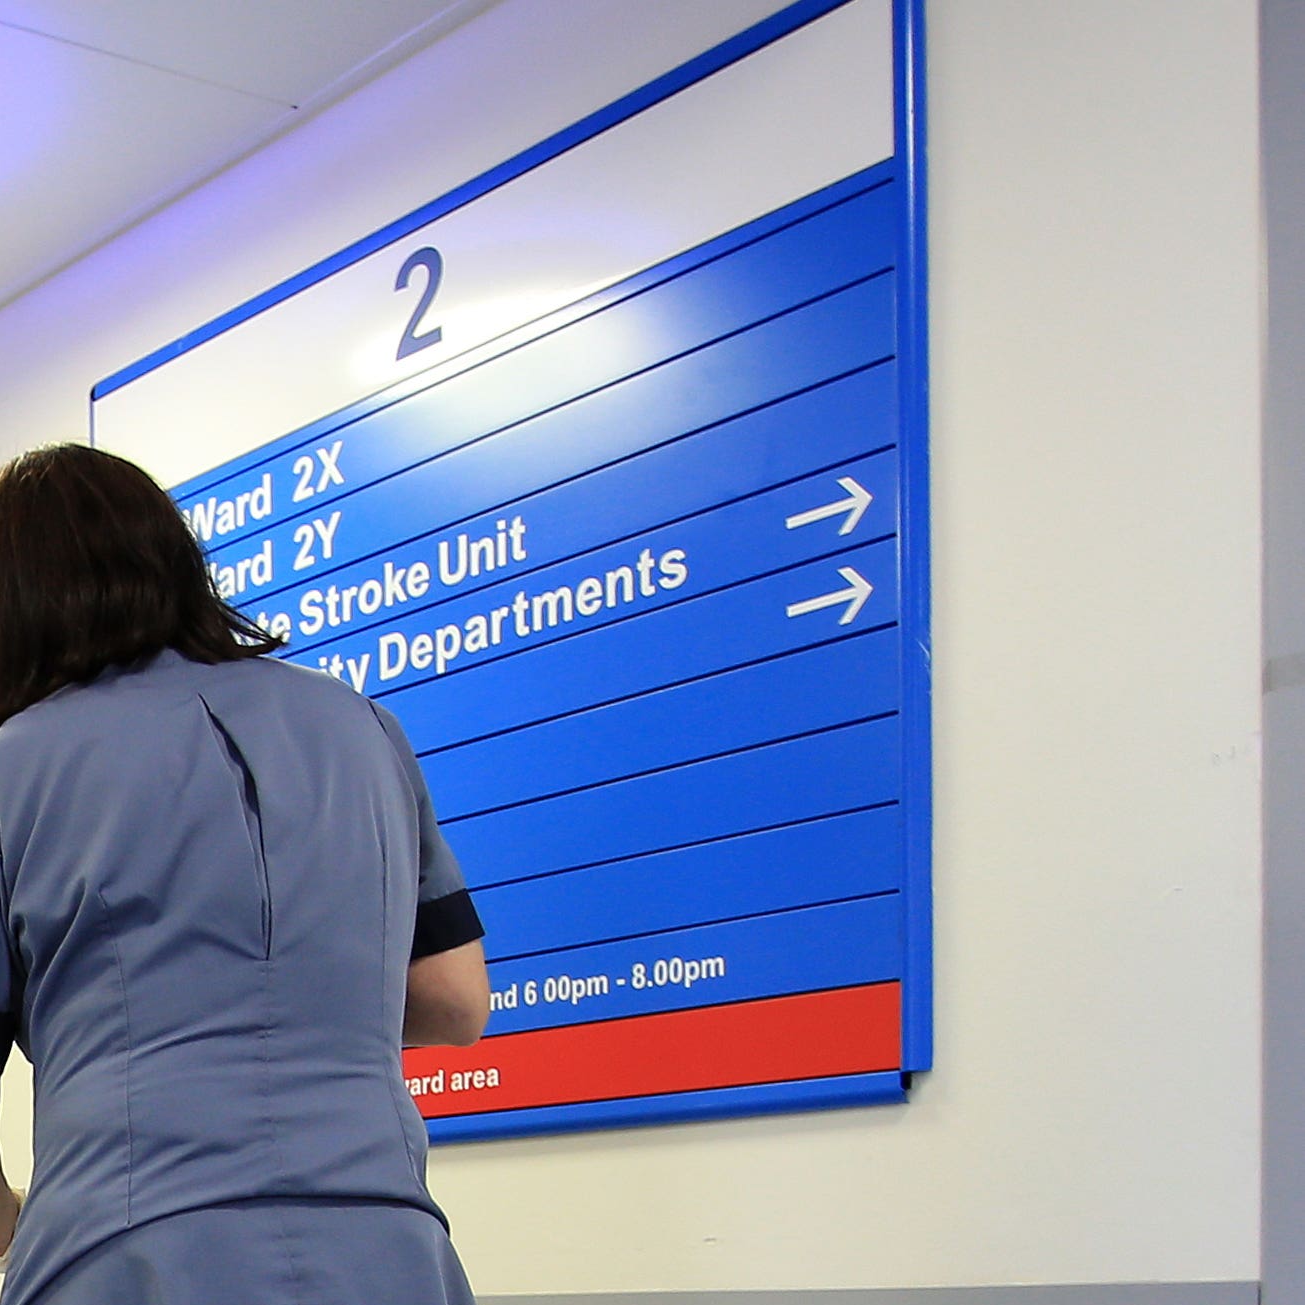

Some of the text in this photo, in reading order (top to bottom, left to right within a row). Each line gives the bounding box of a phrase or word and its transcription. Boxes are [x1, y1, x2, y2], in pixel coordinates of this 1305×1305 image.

[394, 247, 444, 361] 2
[182, 440, 345, 542] Ward 2X
[208, 511, 342, 600] ard 2Y
[298, 560, 431, 636] Stroke
[438, 516, 528, 586] Unit
[378, 548, 689, 675] Departments
[489, 983, 519, 1012] nd
[631, 956, 726, 990] 8.00pm
[450, 1067, 500, 1092] area
